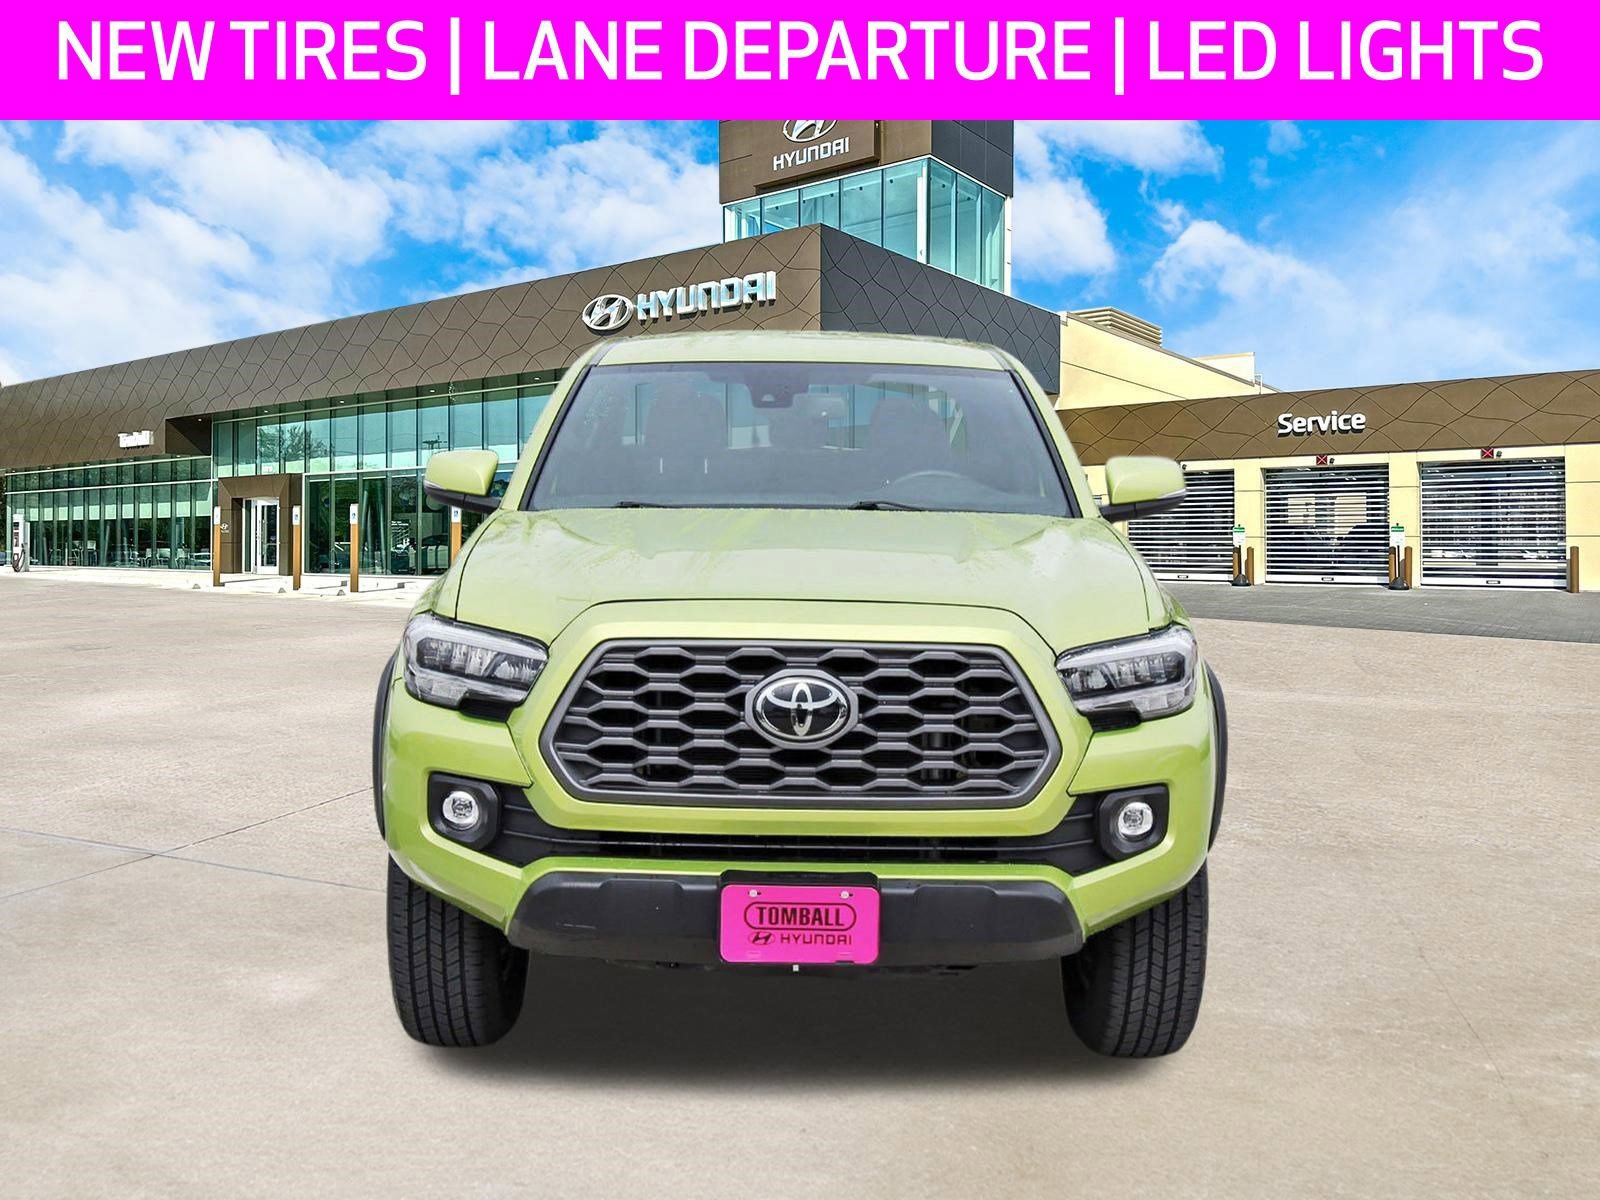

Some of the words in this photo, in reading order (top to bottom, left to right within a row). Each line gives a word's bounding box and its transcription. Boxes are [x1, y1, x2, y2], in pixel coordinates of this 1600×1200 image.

[773, 136, 850, 171] HYUNDAI
[637, 270, 777, 321] HYUNDAI
[1277, 410, 1367, 434] Service
[756, 906, 845, 926] TOMBALL
[780, 933, 852, 945] HYUNDAI
